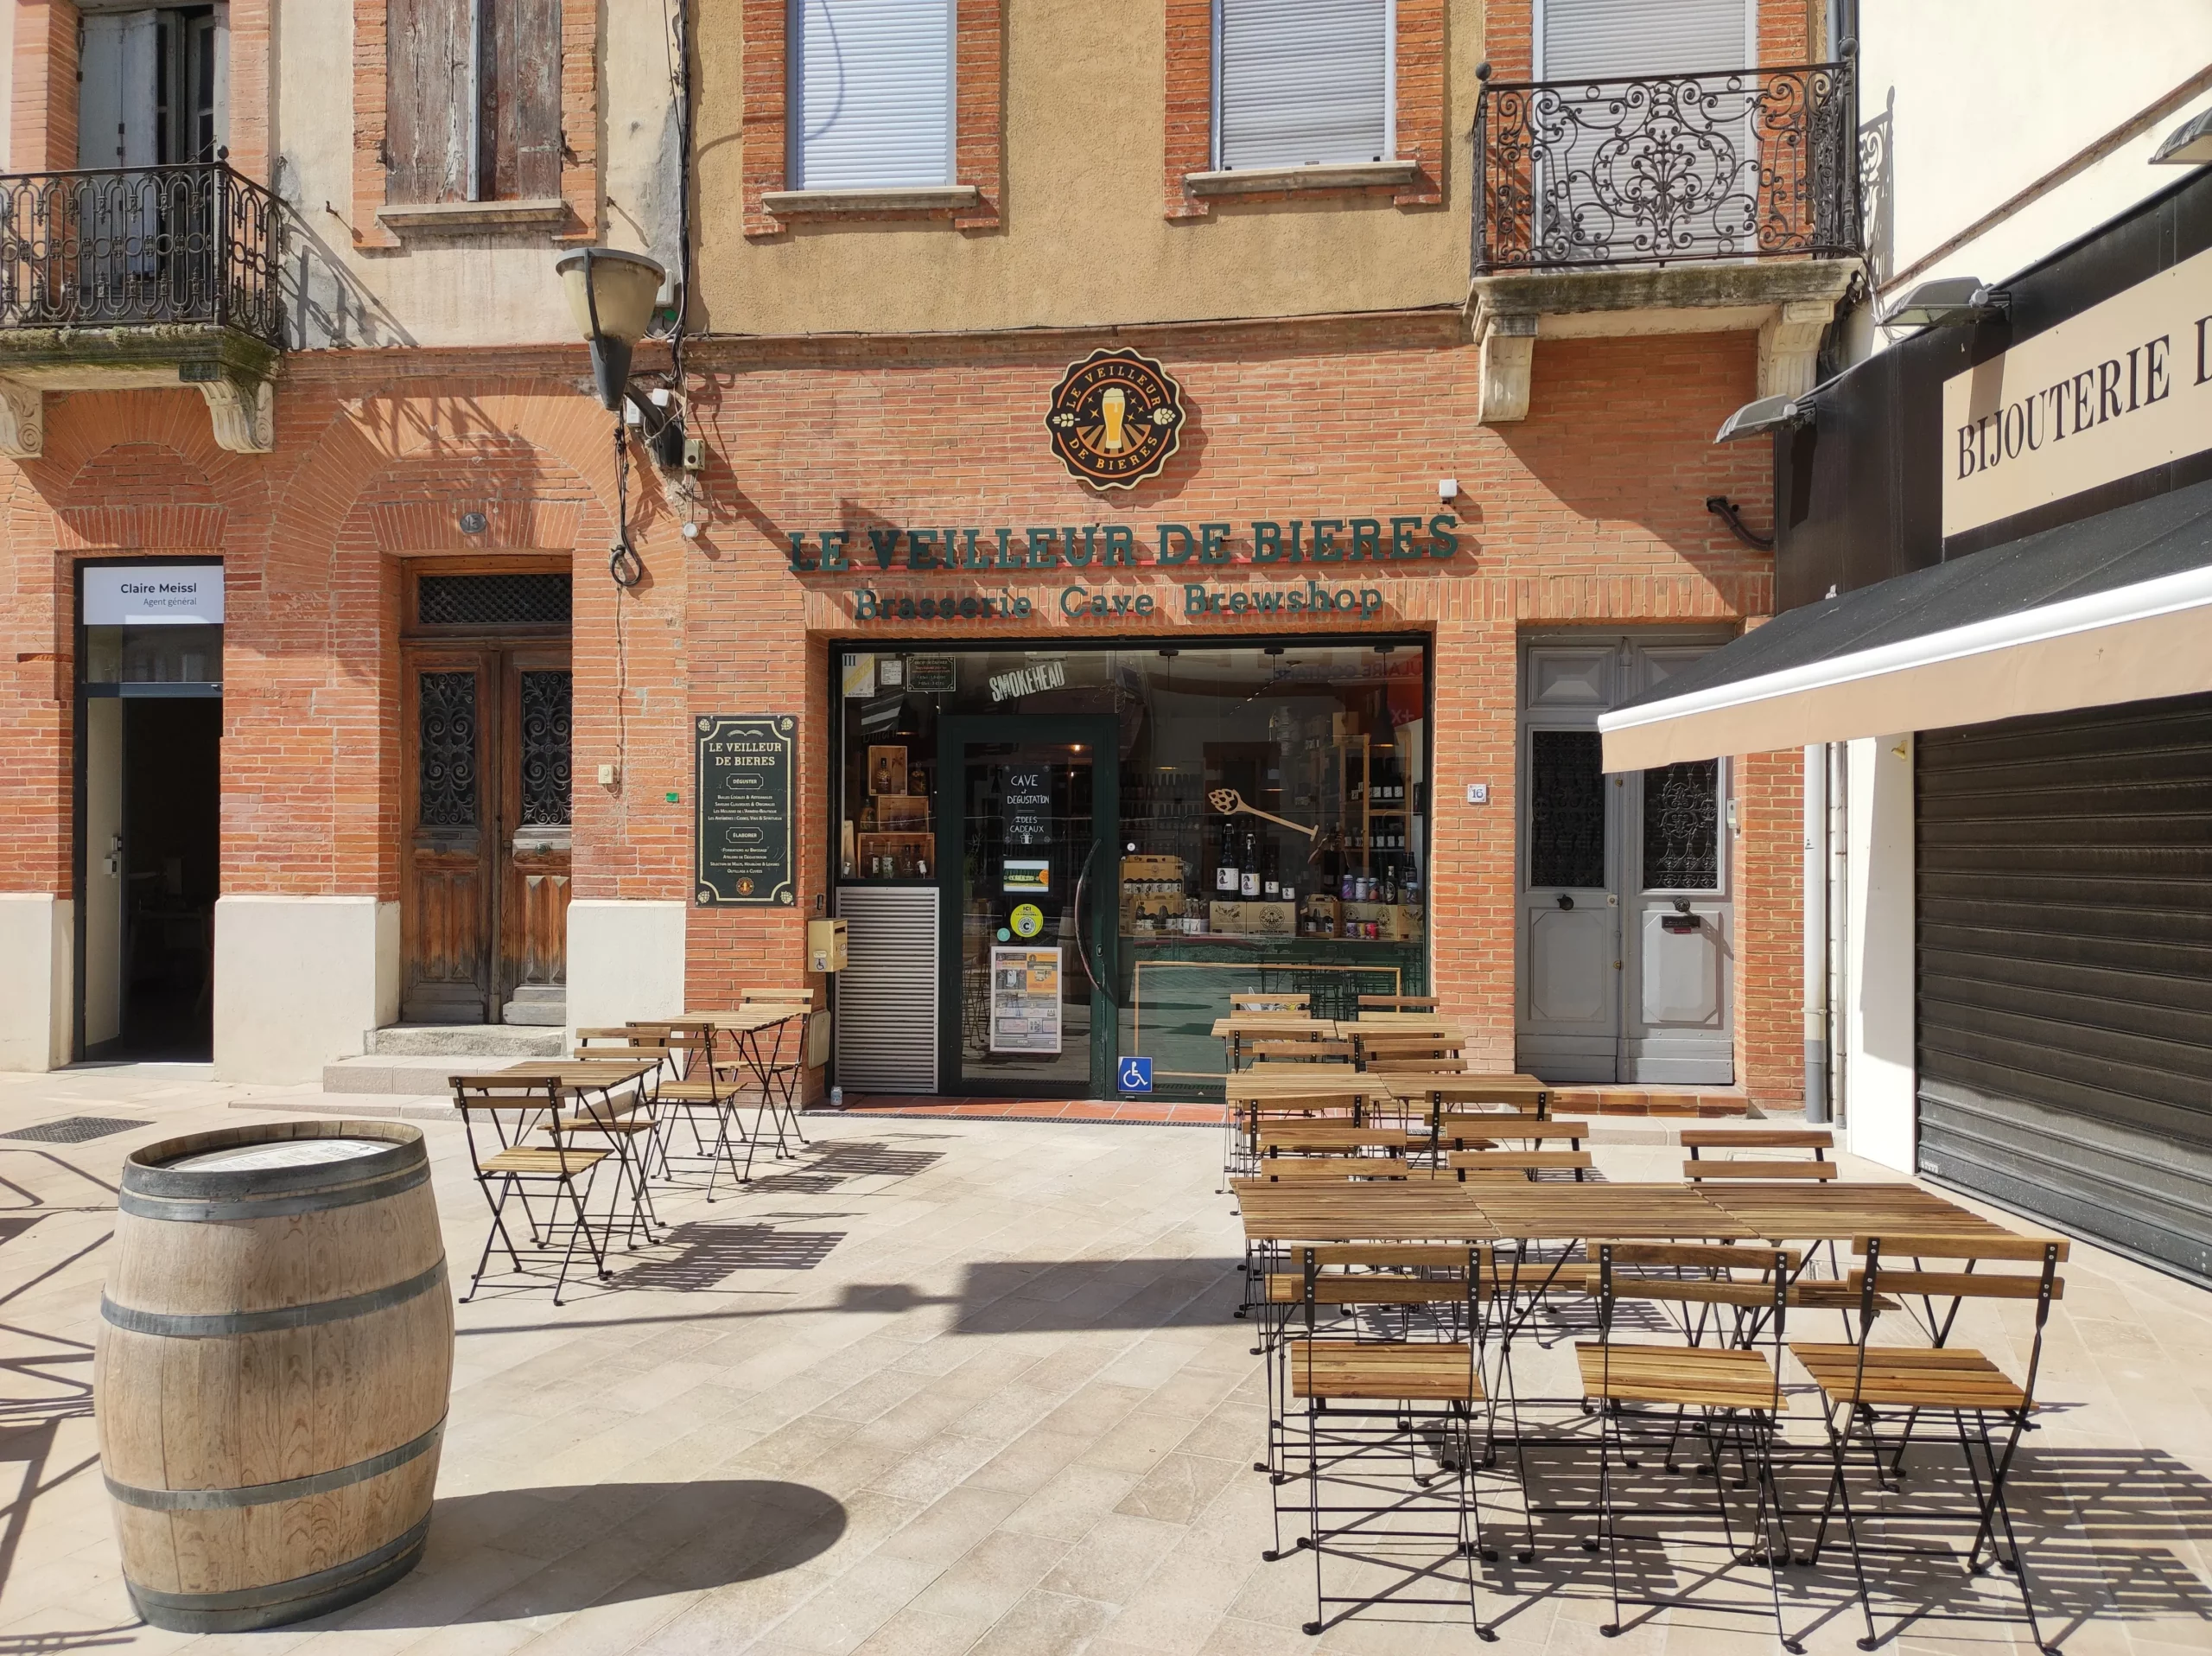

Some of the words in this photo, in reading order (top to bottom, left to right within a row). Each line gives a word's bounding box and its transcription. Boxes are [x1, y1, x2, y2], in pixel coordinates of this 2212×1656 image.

[1066, 387, 1081, 409] LE
[1084, 366, 1161, 406] VEILLEUR
[1956, 334, 2171, 481] BIJOUTERIE
[1069, 438, 1089, 460] DE
[1096, 436, 1158, 470] BIERES
[788, 530, 849, 571] LE
[868, 525, 1136, 570] VEILLEUR
[1156, 523, 1230, 564] DE
[1251, 514, 1459, 563] BIERES
[120, 583, 156, 594] Claire
[159, 582, 197, 594] Meissl
[143, 597, 167, 608] Agent
[168, 596, 197, 608] général
[854, 588, 1032, 621] Brasserie
[1060, 586, 1154, 618] Cave
[1184, 581, 1382, 621] Brewshop
[988, 661, 1065, 702] SMOKEHEAD
[709, 742, 723, 752] LE
[726, 742, 782, 752] VEILLEUR
[715, 756, 732, 766] DE
[734, 756, 775, 766] BIERES
[1010, 774, 1039, 787] CAVE
[1471, 788, 1484, 799] 16
[1009, 825, 1045, 833] CADEAUX
